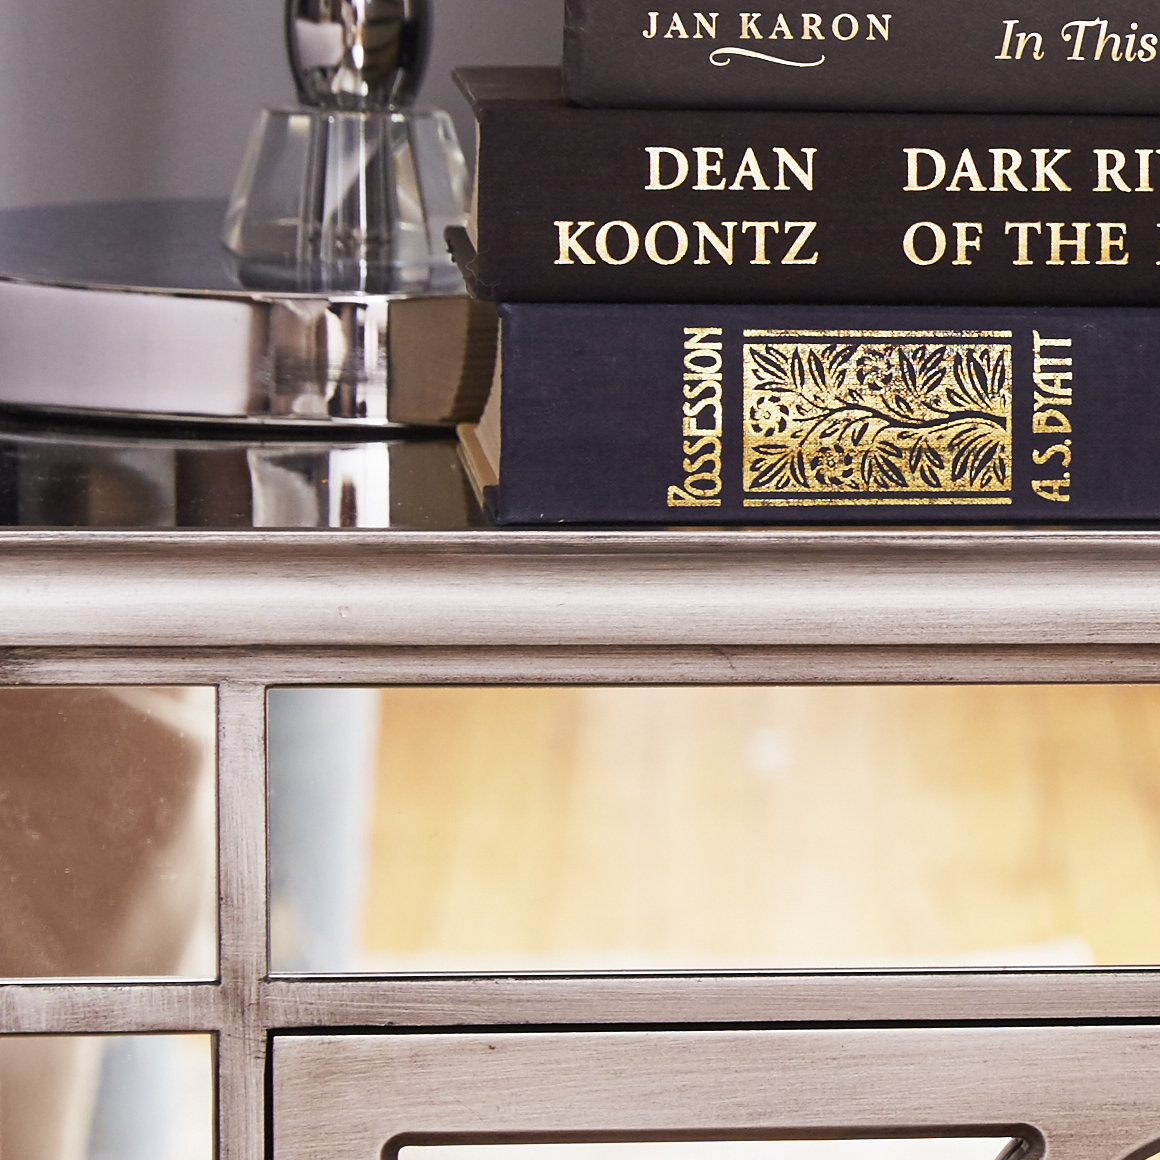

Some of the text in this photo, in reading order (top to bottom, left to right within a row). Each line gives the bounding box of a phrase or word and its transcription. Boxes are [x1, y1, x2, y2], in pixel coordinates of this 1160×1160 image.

[642, 11, 893, 41] JAN KARON
[994, 19, 1045, 61] In
[1060, 16, 1159, 63] This
[644, 146, 819, 191] DEAN
[902, 147, 1073, 192] DARK
[553, 219, 819, 266] KOONTZ
[902, 221, 984, 266] OF
[1004, 221, 1130, 266] THE
[666, 326, 723, 507] POSSESSION
